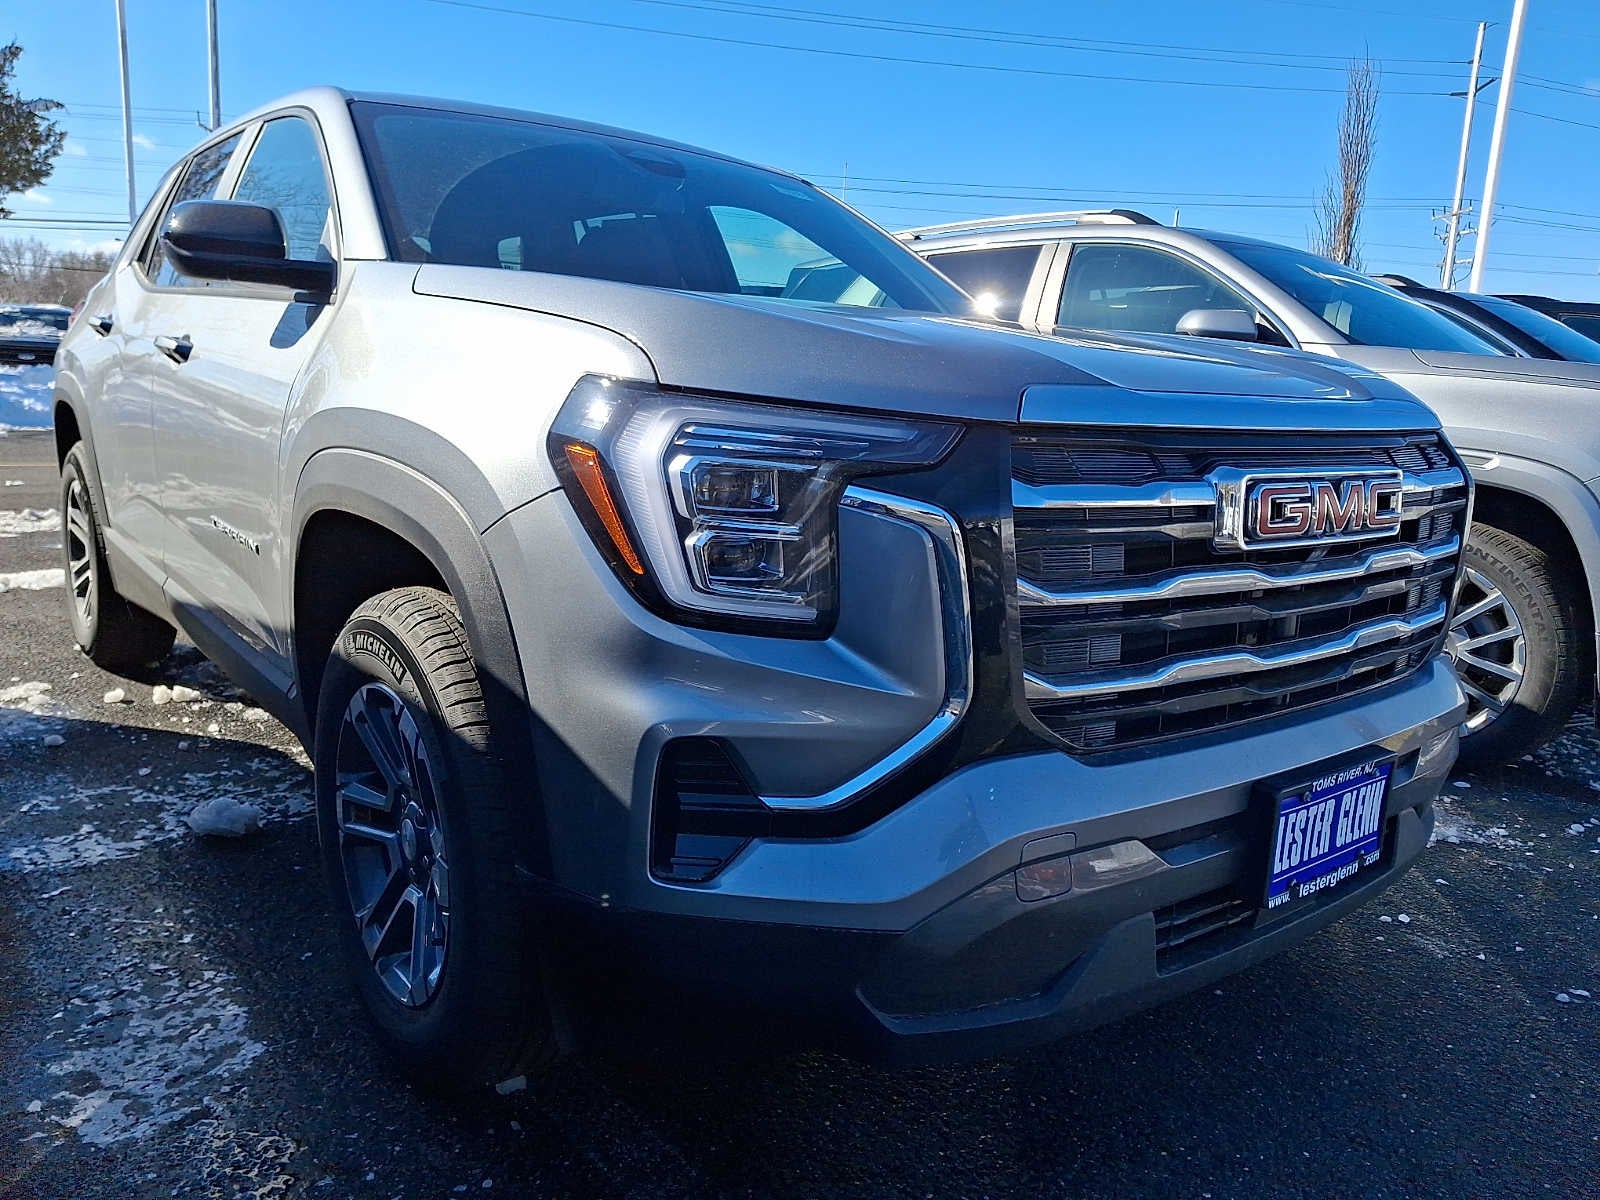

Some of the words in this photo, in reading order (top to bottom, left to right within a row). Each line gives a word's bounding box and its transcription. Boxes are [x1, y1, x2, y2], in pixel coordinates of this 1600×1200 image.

[1257, 480, 1402, 536] GMC
[1462, 543, 1549, 649] ONTINENTAL
[355, 634, 404, 680] MICHELIN
[1312, 773, 1337, 792] TOMS
[1363, 760, 1376, 775] NJ
[1273, 798, 1336, 875] LESTER
[1335, 779, 1386, 848] GLENN
